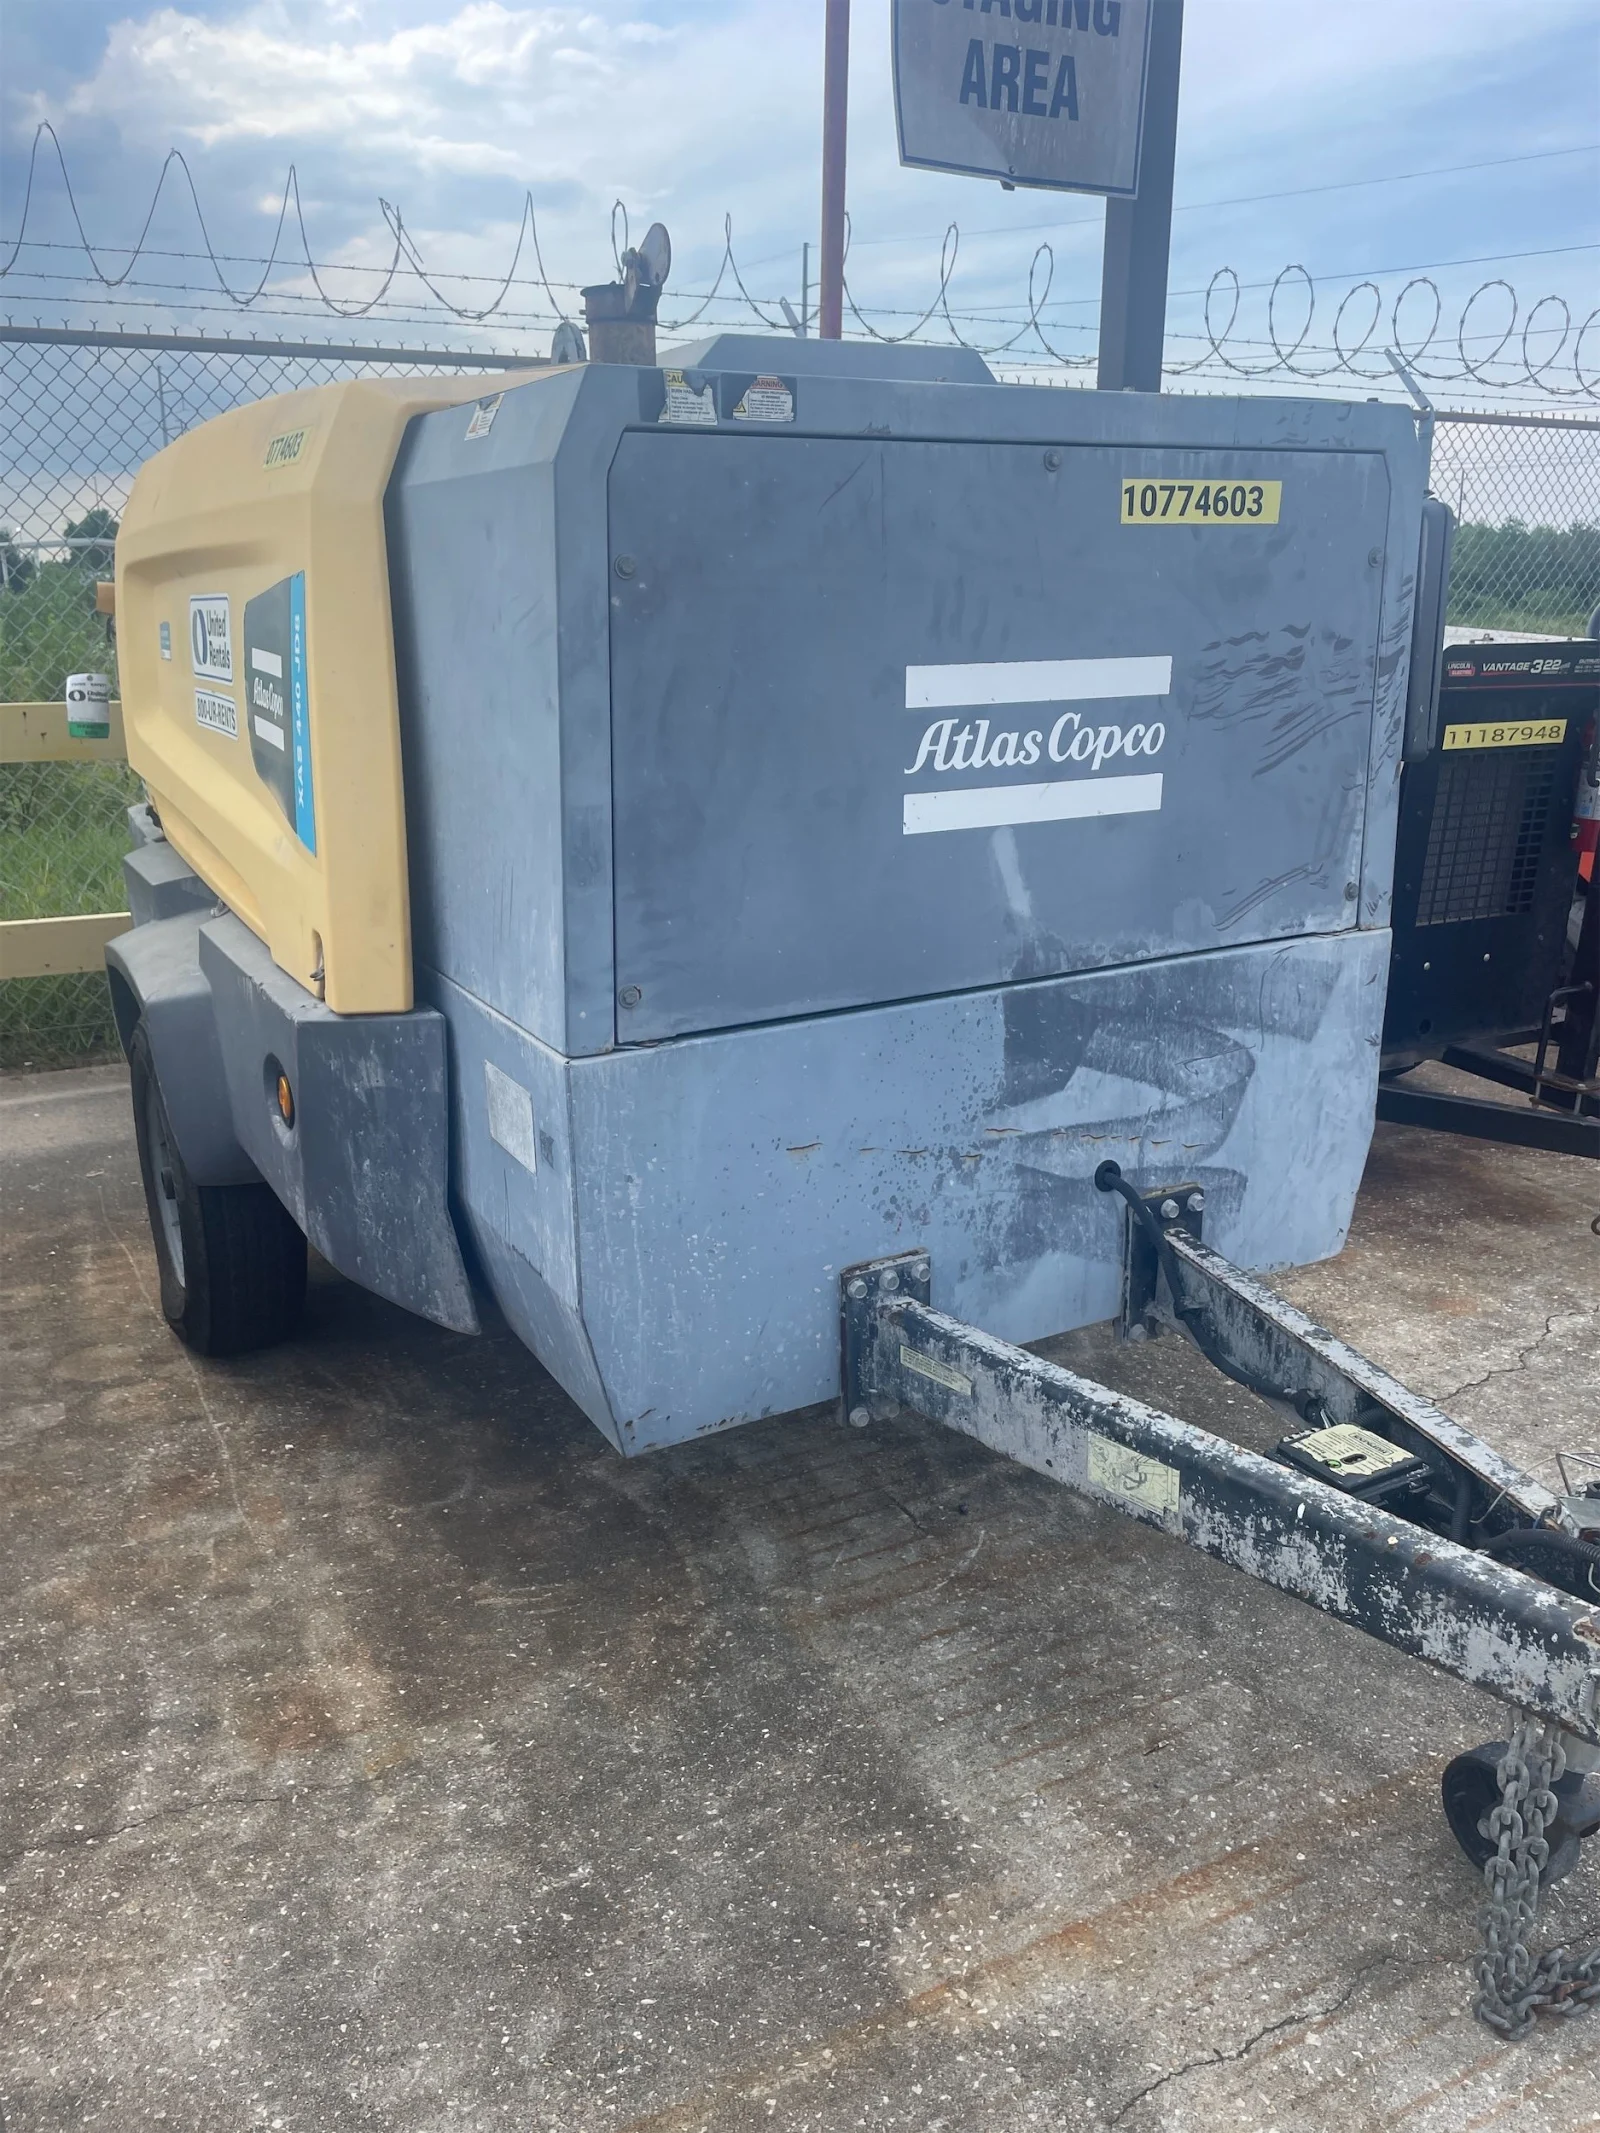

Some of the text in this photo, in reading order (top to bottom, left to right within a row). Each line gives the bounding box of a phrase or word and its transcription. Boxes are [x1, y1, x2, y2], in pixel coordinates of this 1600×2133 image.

[959, 38, 1079, 122] AREA
[754, 379, 783, 388] ARNING
[1124, 484, 1264, 517] 10774603
[206, 609, 226, 638] United
[208, 639, 231, 669] Rentals
[1482, 662, 1531, 672] VANTAGE
[1530, 659, 1562, 673] 322
[904, 712, 1166, 774] Atlas Copco
[1449, 725, 1561, 745] 11187948
